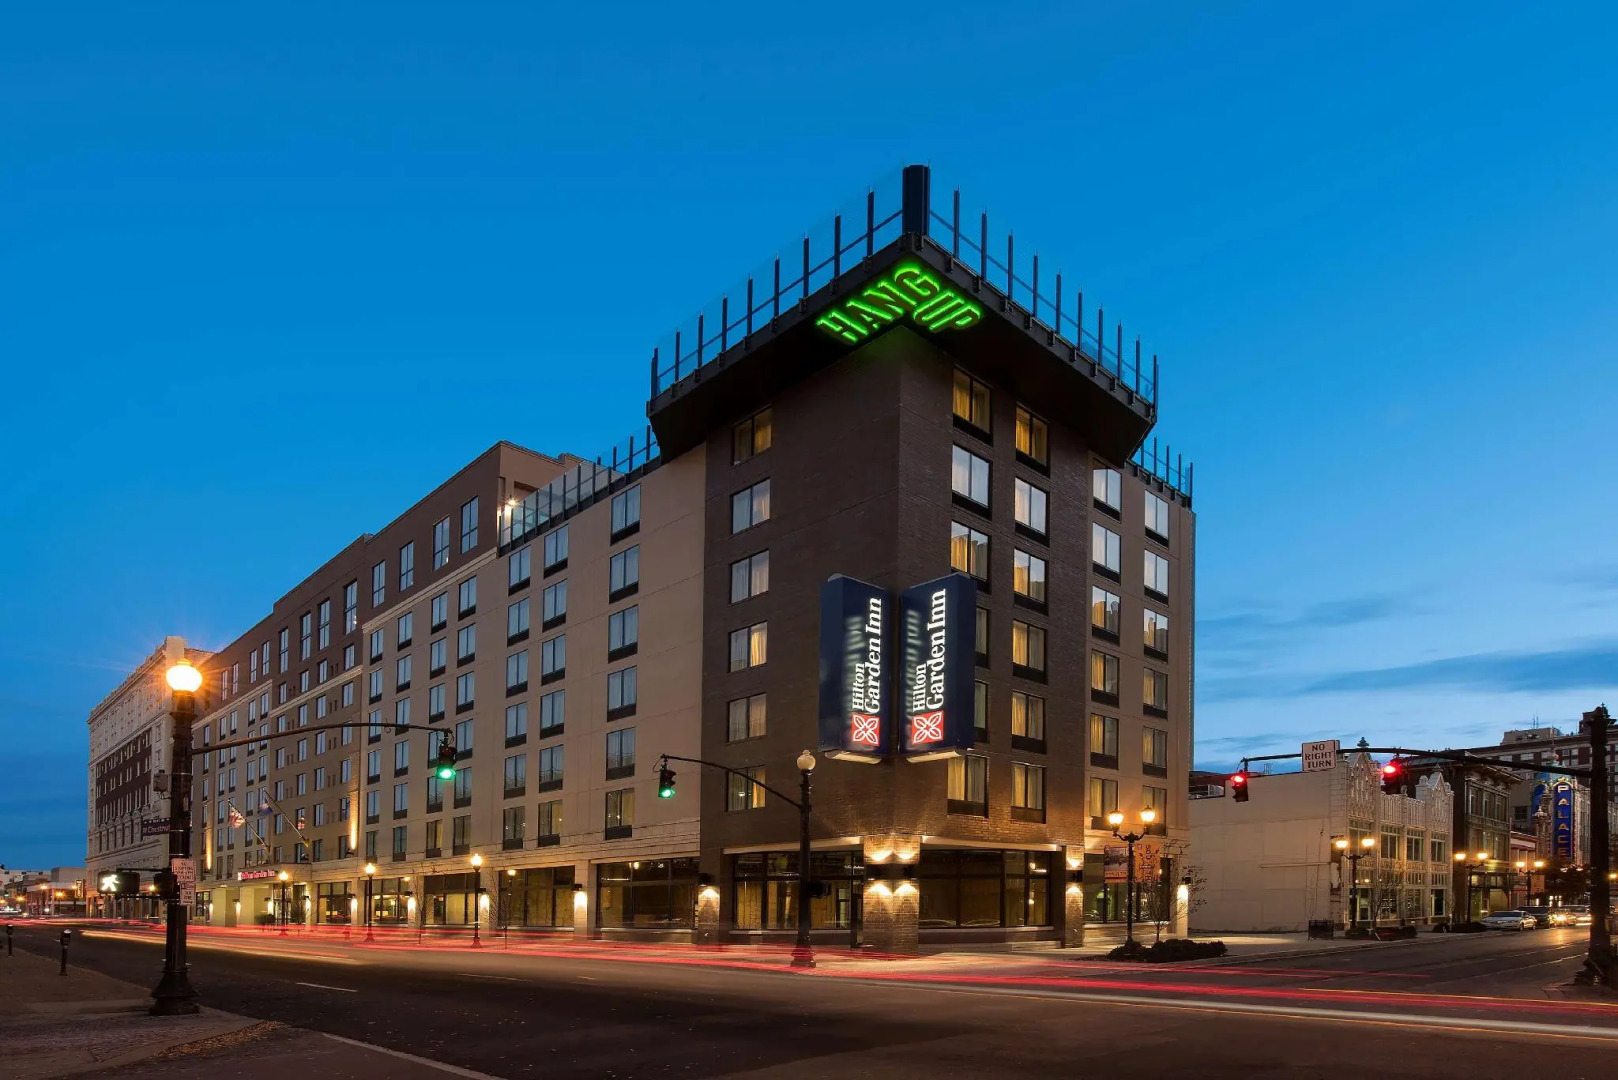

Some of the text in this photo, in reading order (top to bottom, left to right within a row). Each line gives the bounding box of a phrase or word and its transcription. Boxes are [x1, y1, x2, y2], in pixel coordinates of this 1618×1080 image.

[816, 267, 981, 345] HANG UP
[865, 598, 882, 714] Garden Inn
[926, 589, 946, 709] Garden Inn
[852, 663, 865, 711] Hilton
[912, 663, 927, 712] Hilton
[1305, 751, 1332, 761] RIGHT
[1307, 760, 1332, 768] TURN
[1312, 743, 1325, 751] NO
[1557, 785, 1570, 857] PALACE
